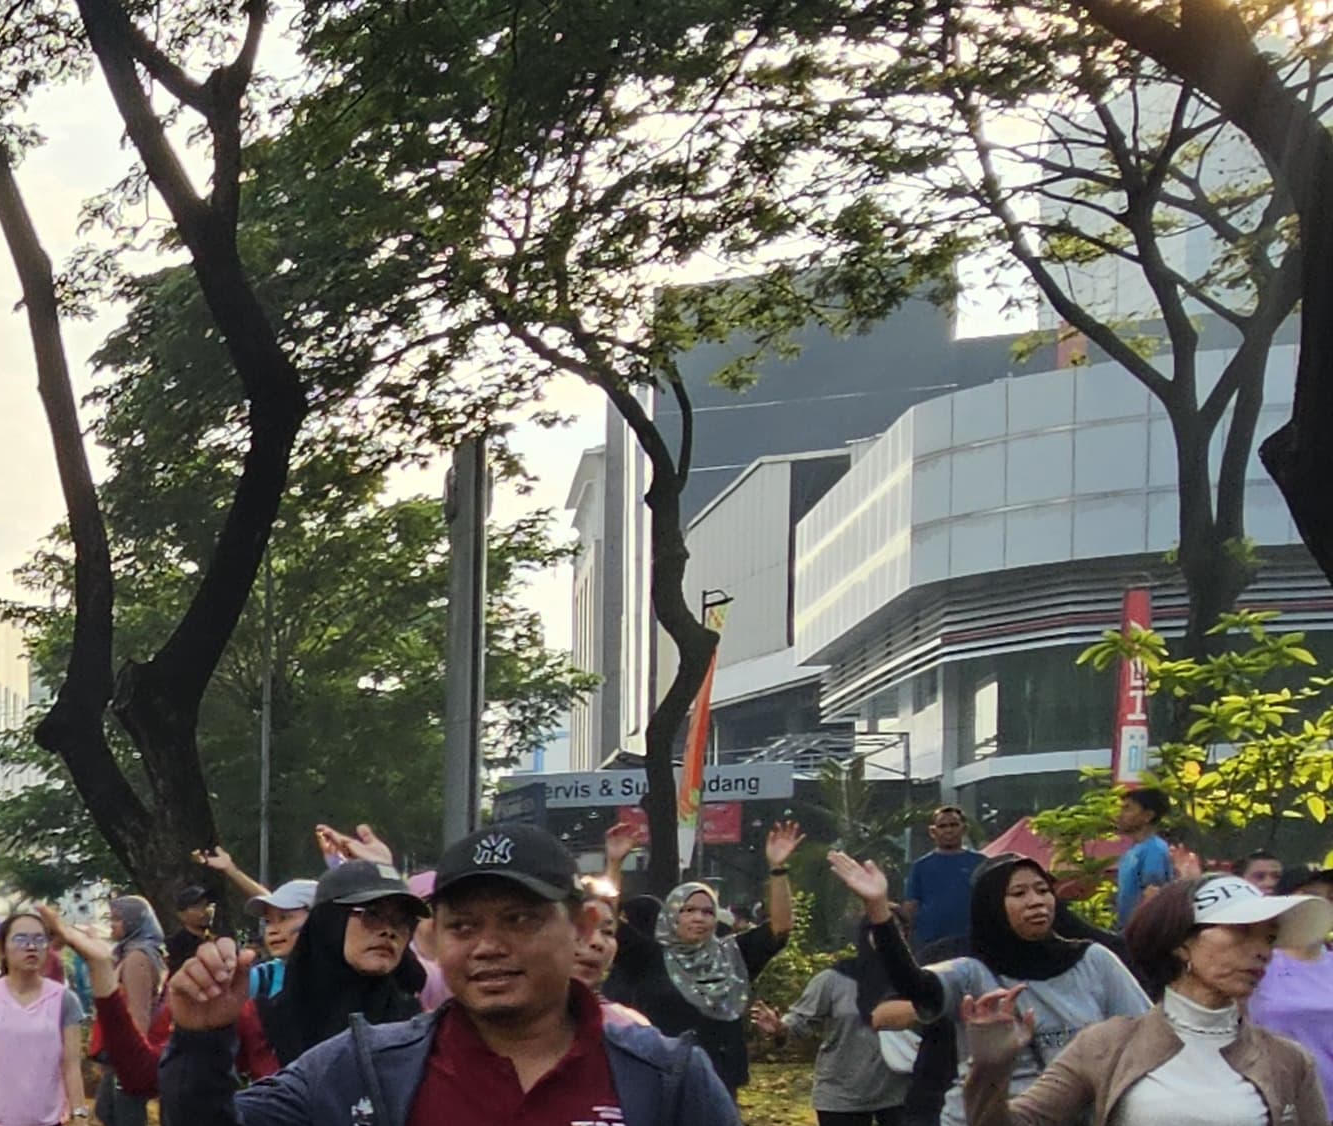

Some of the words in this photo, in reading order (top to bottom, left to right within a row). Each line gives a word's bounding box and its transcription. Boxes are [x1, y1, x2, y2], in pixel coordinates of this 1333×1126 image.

[545, 780, 591, 799] ervis
[599, 778, 614, 797] &
[703, 774, 760, 795] dang
